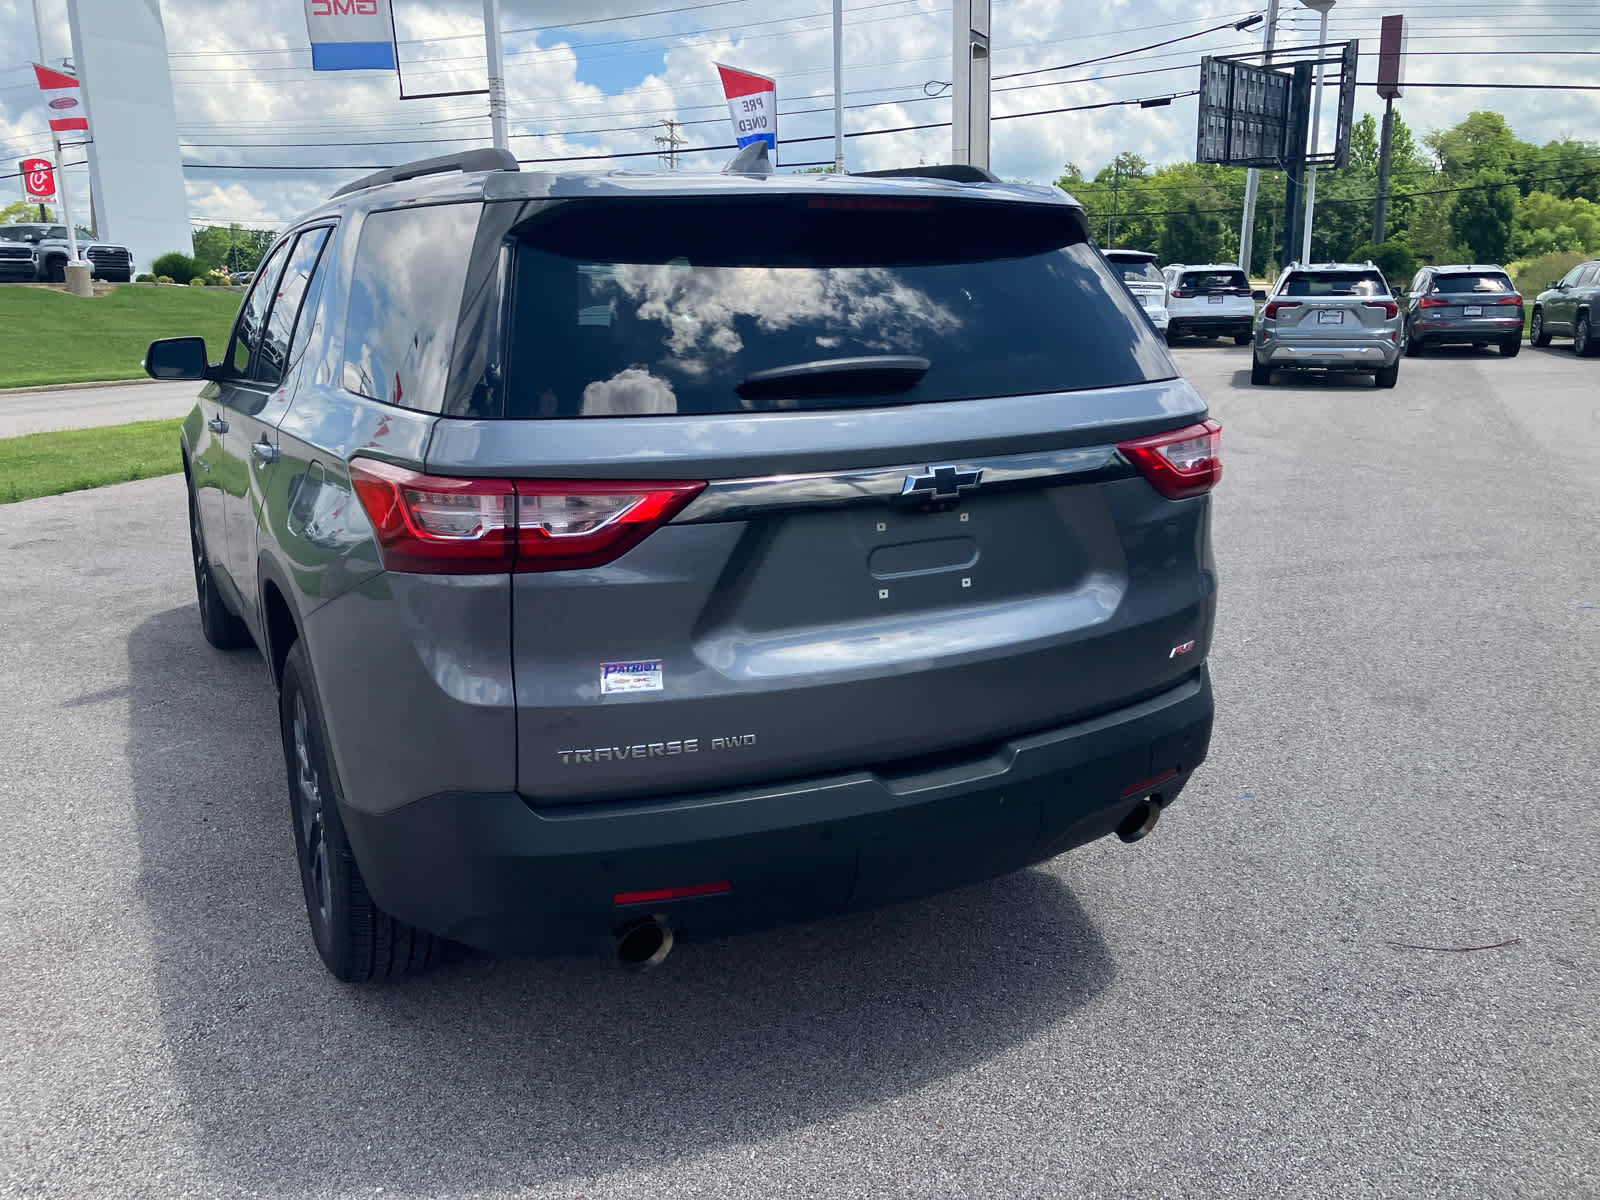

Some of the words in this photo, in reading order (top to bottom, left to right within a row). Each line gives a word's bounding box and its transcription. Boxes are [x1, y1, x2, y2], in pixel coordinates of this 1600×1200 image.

[604, 661, 659, 680] PATRIOT
[557, 738, 699, 765] TRAVERSE
[711, 734, 756, 750] AWD
